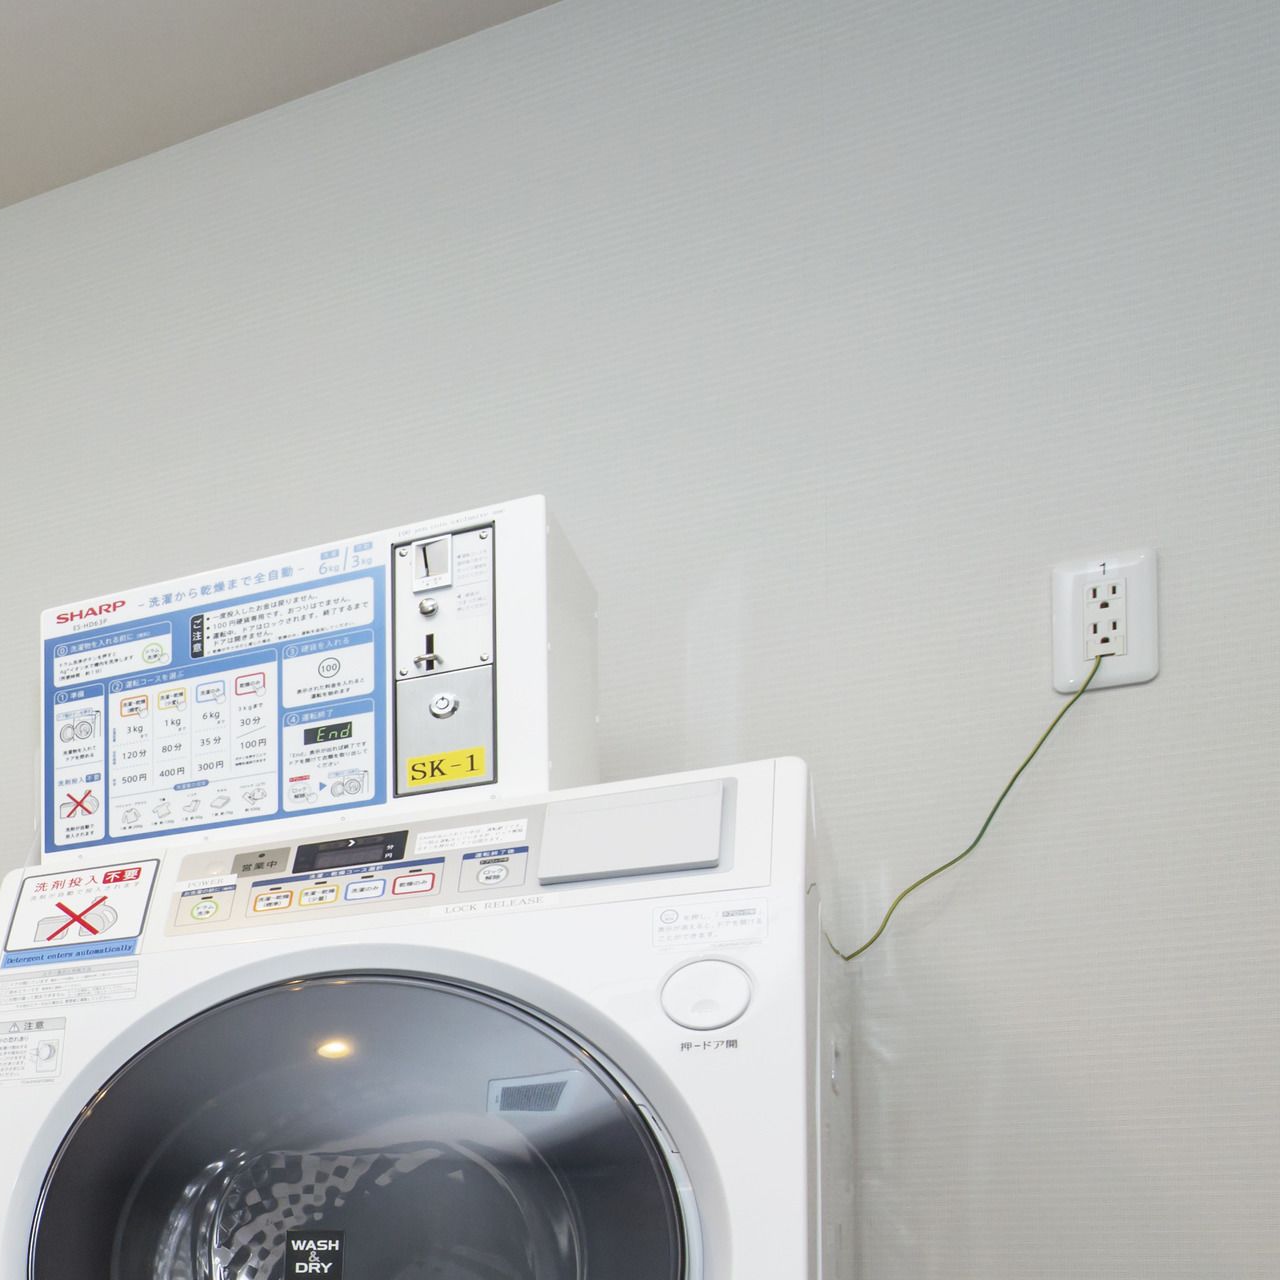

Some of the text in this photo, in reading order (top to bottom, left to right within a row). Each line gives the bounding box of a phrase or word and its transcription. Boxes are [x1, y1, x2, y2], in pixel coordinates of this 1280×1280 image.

[1099, 562, 1106, 575] 1
[56, 600, 126, 624] SHARP
[320, 662, 338, 674] 100
[316, 722, 352, 743] End
[410, 754, 479, 782] SK-1
[242, 861, 278, 872] 営業中
[105, 868, 141, 882] 不要
[33, 875, 99, 894] 洗剤投入
[445, 896, 545, 914] LOCK RELEASE
[6, 943, 133, 965] Detergent enters automatically
[291, 1239, 340, 1251] WASH
[308, 1250, 321, 1262] &
[295, 1262, 333, 1274] DRY
